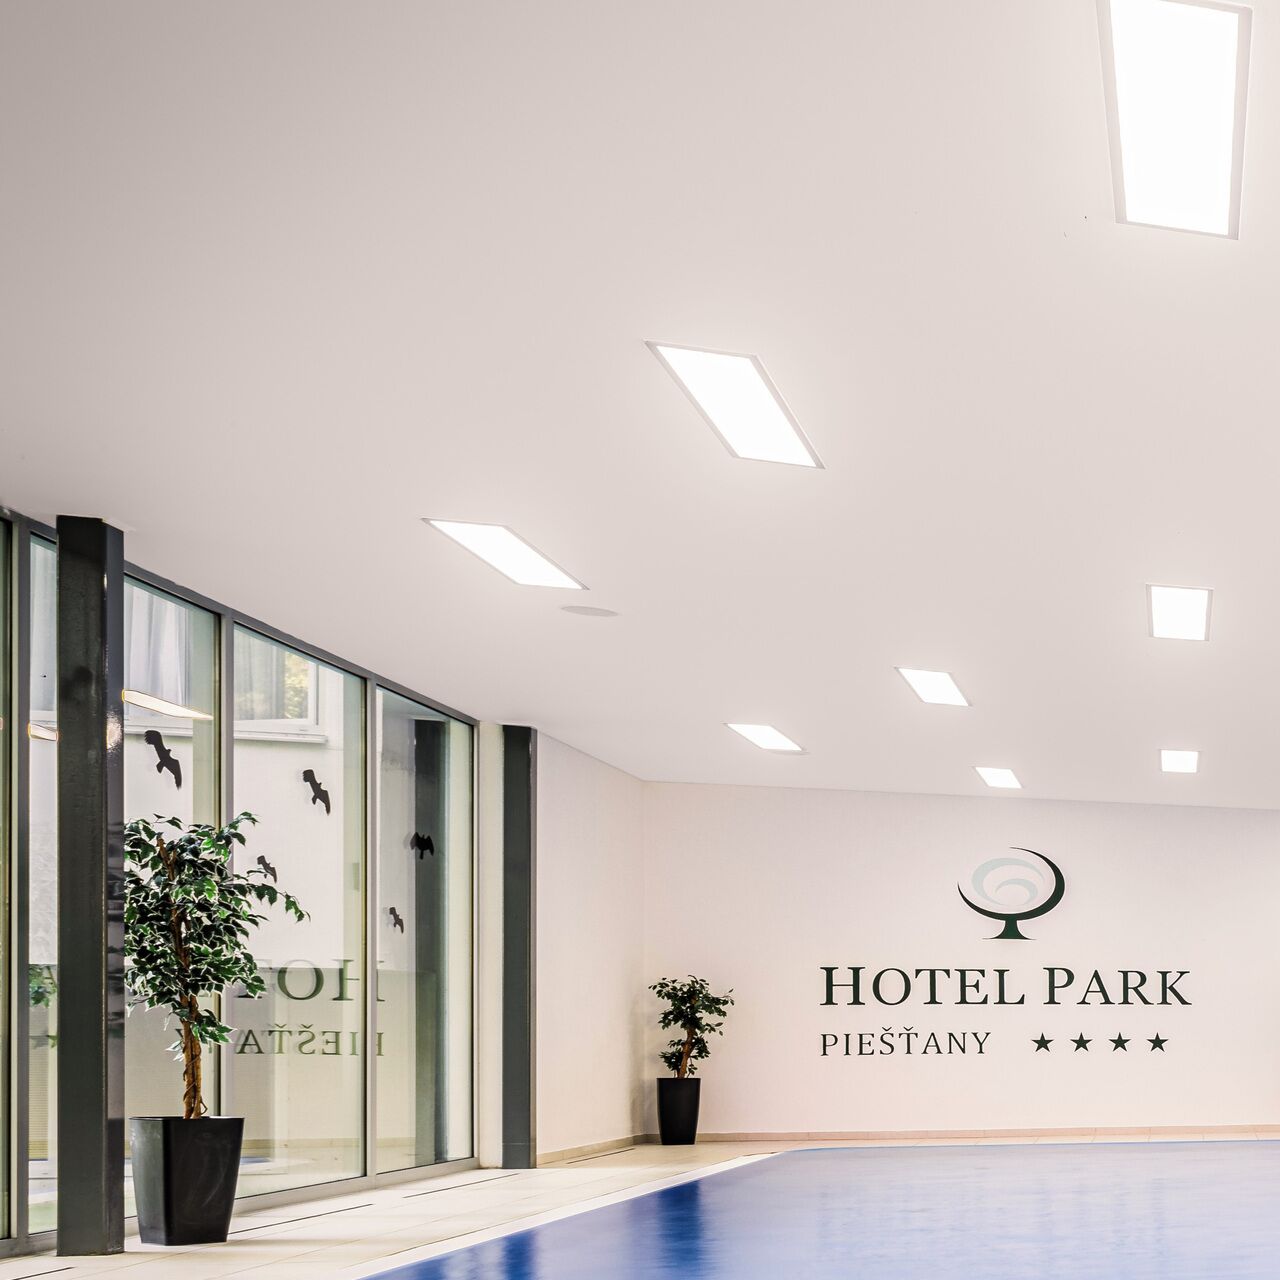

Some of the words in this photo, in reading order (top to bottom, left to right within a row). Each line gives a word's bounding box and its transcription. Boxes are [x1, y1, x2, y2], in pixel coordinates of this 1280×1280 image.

[819, 966, 1025, 1006] HOTEL
[1042, 966, 1193, 1006] PARK
[820, 1026, 992, 1057] PIEŠŤANY
